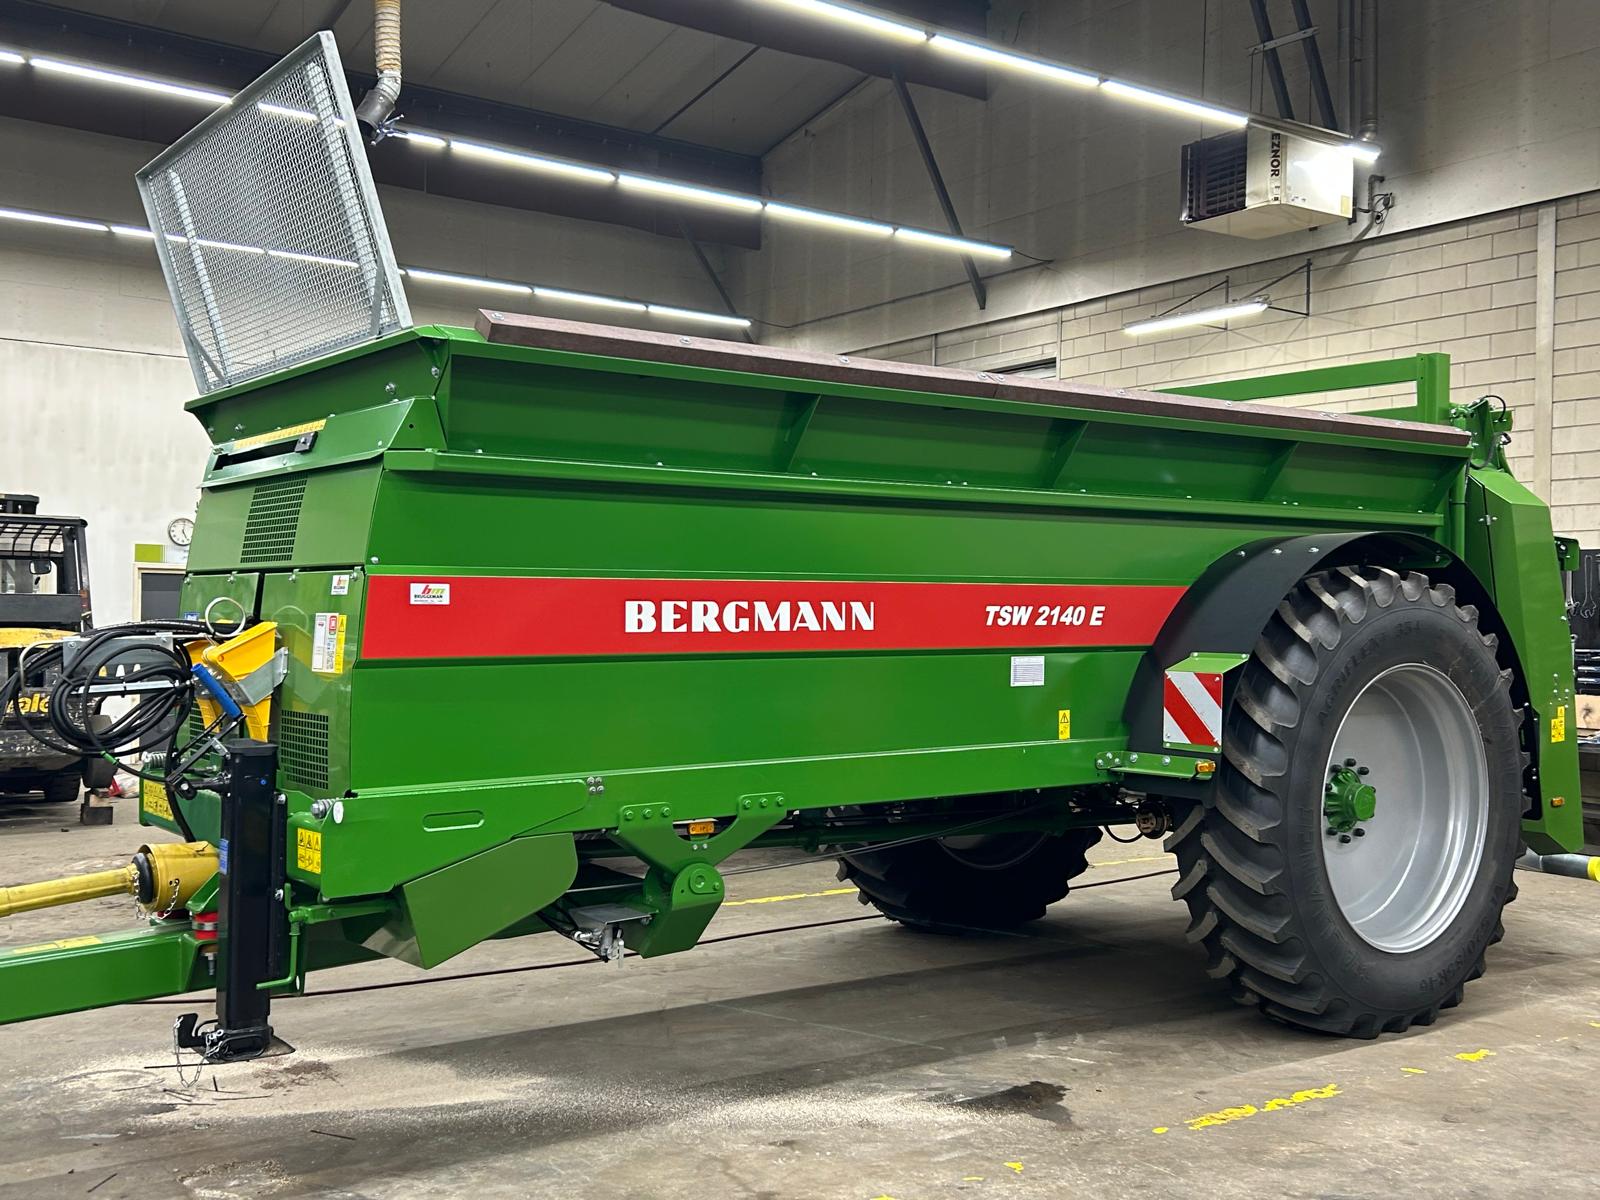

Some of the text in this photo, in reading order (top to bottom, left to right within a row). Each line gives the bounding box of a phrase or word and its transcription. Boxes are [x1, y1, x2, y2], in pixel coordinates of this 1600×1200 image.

[1270, 133, 1281, 178] EZNOR
[624, 600, 875, 633] BERGMANN
[985, 605, 1106, 626] TSW 2140 E
